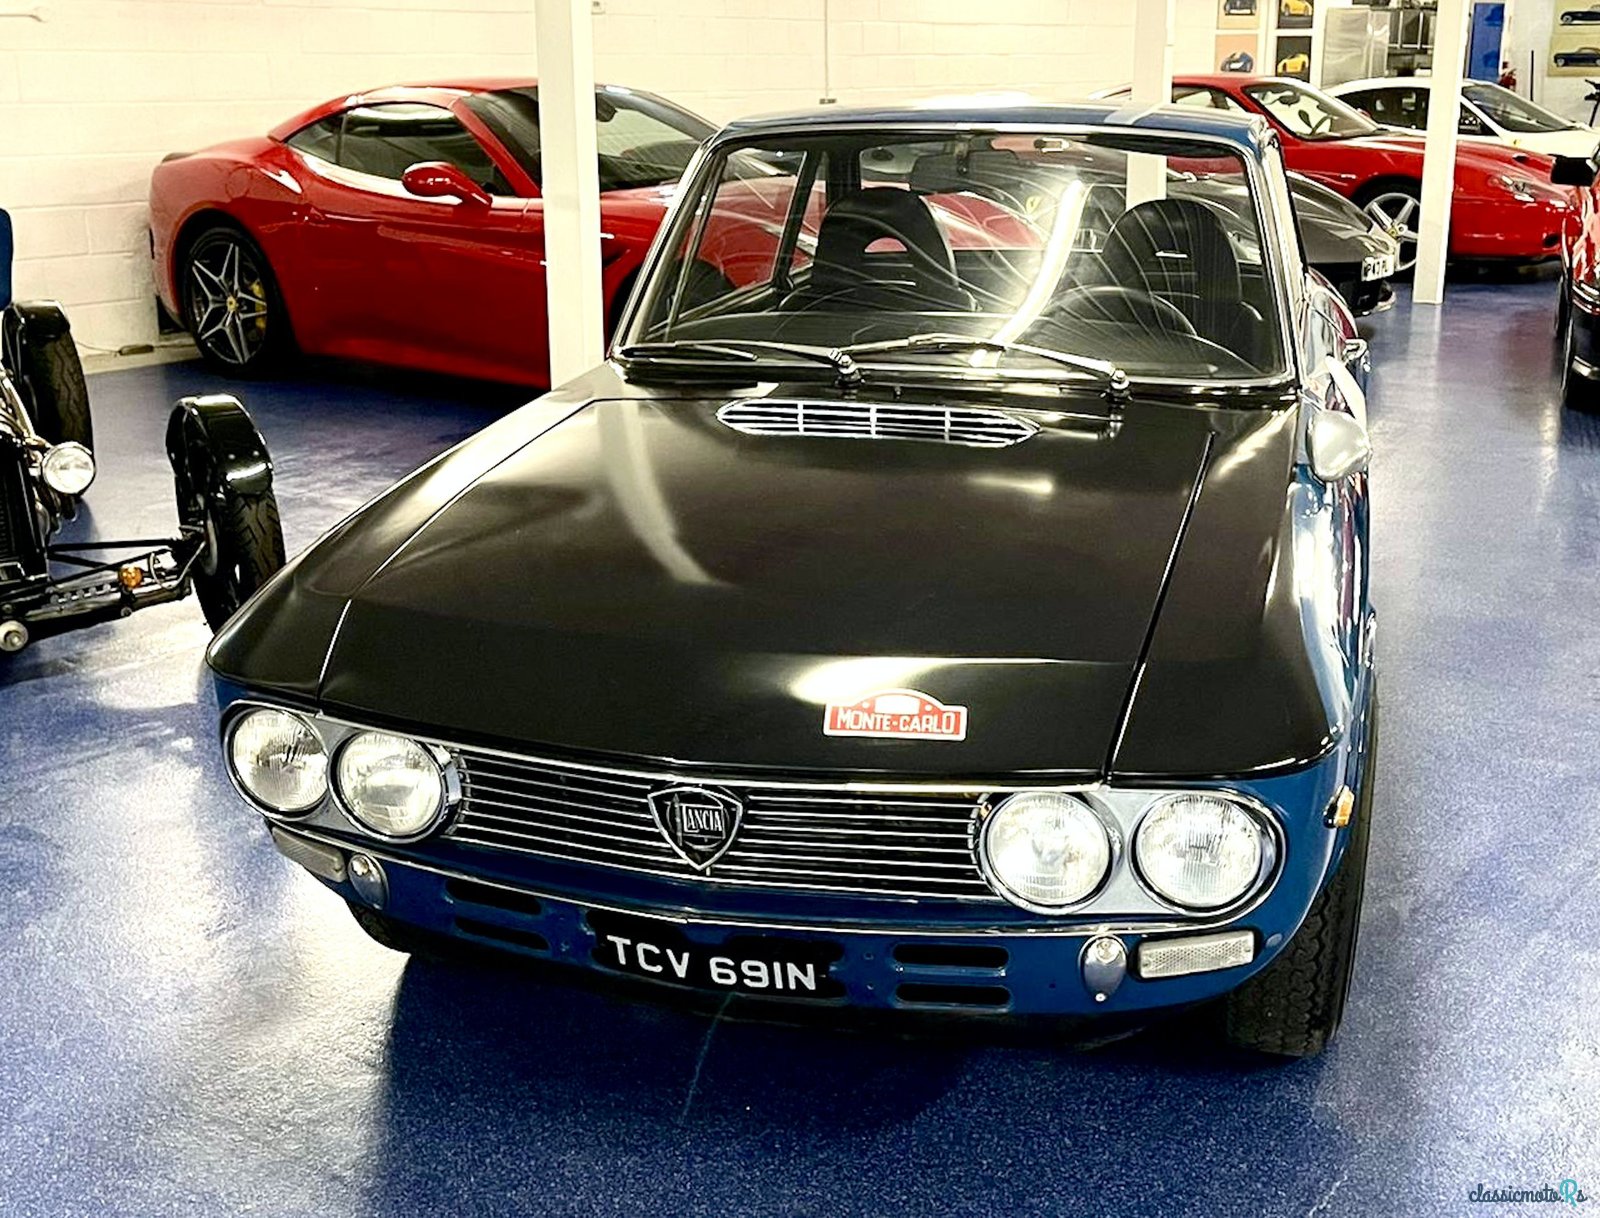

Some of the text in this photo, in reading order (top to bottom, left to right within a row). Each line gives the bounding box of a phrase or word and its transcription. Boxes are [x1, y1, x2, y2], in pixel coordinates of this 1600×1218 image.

[681, 804, 723, 833] LANCIA
[606, 934, 816, 990] TCV 691N
